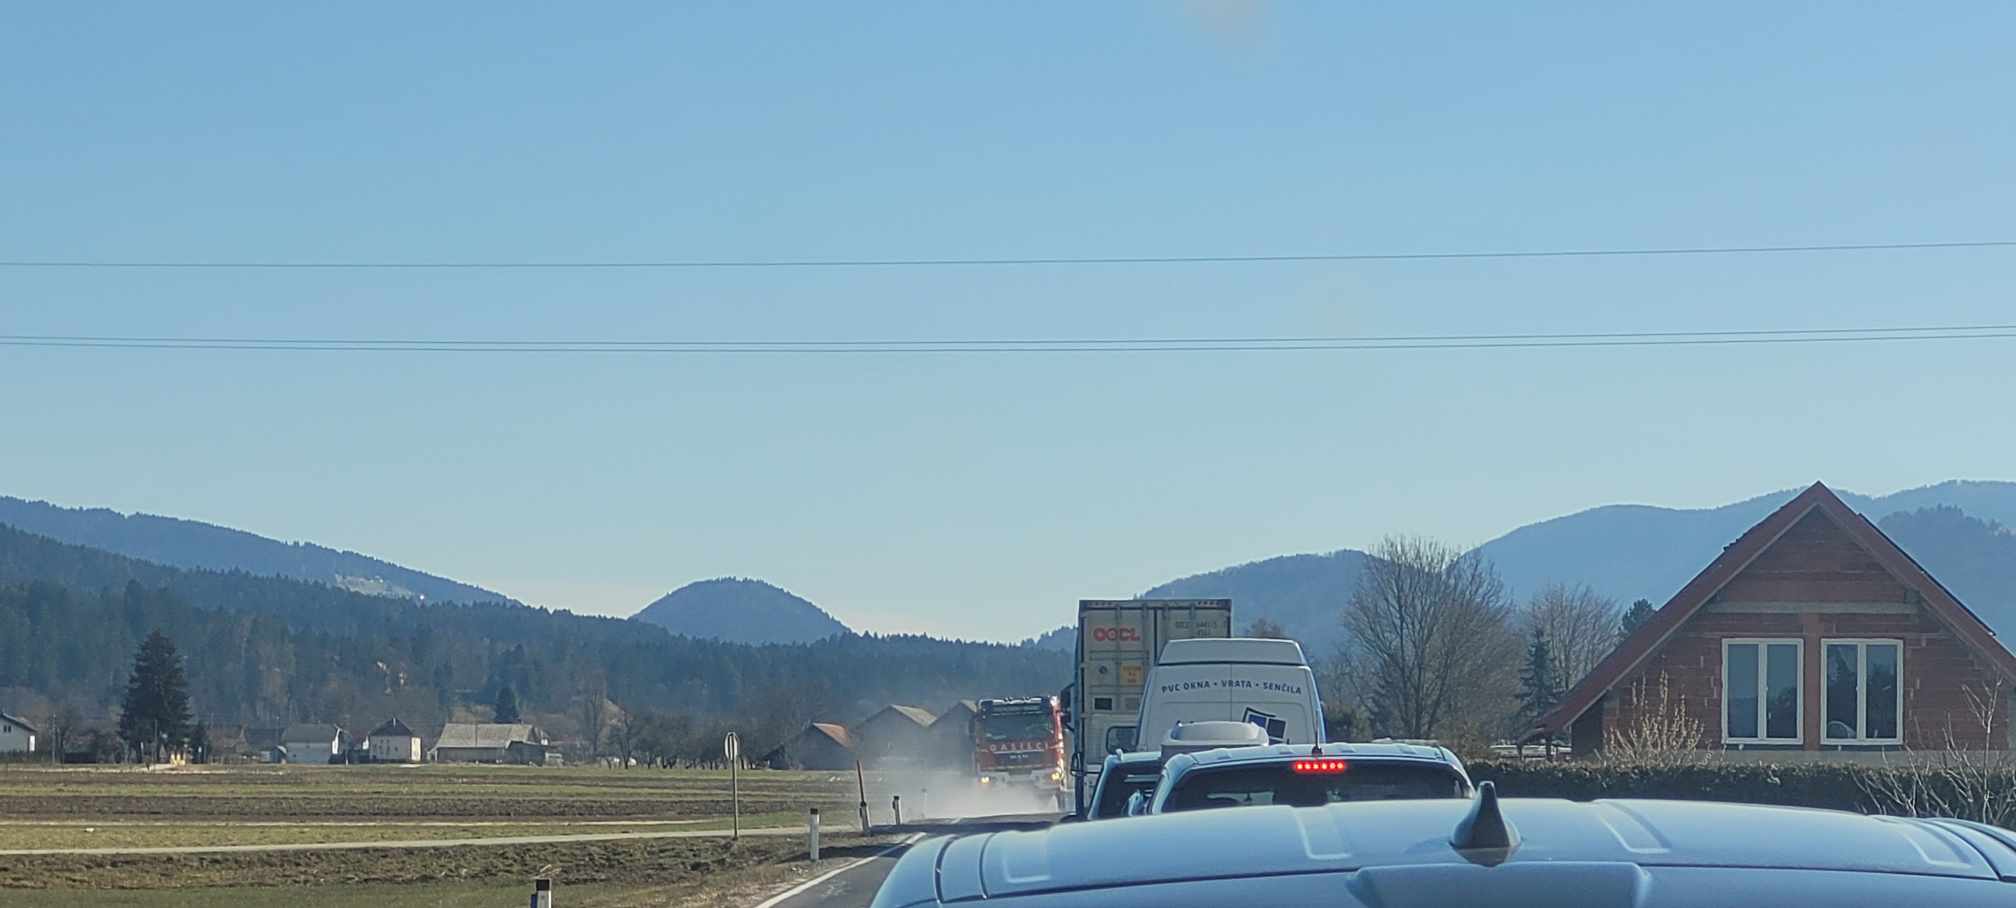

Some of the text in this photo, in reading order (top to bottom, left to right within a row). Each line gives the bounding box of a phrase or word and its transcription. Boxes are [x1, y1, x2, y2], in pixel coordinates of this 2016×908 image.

[1093, 627, 1141, 641] OOCL
[1162, 680, 1302, 695] PVC OKNA VRATA SENČILA
[990, 742, 1048, 752] GASILCI
